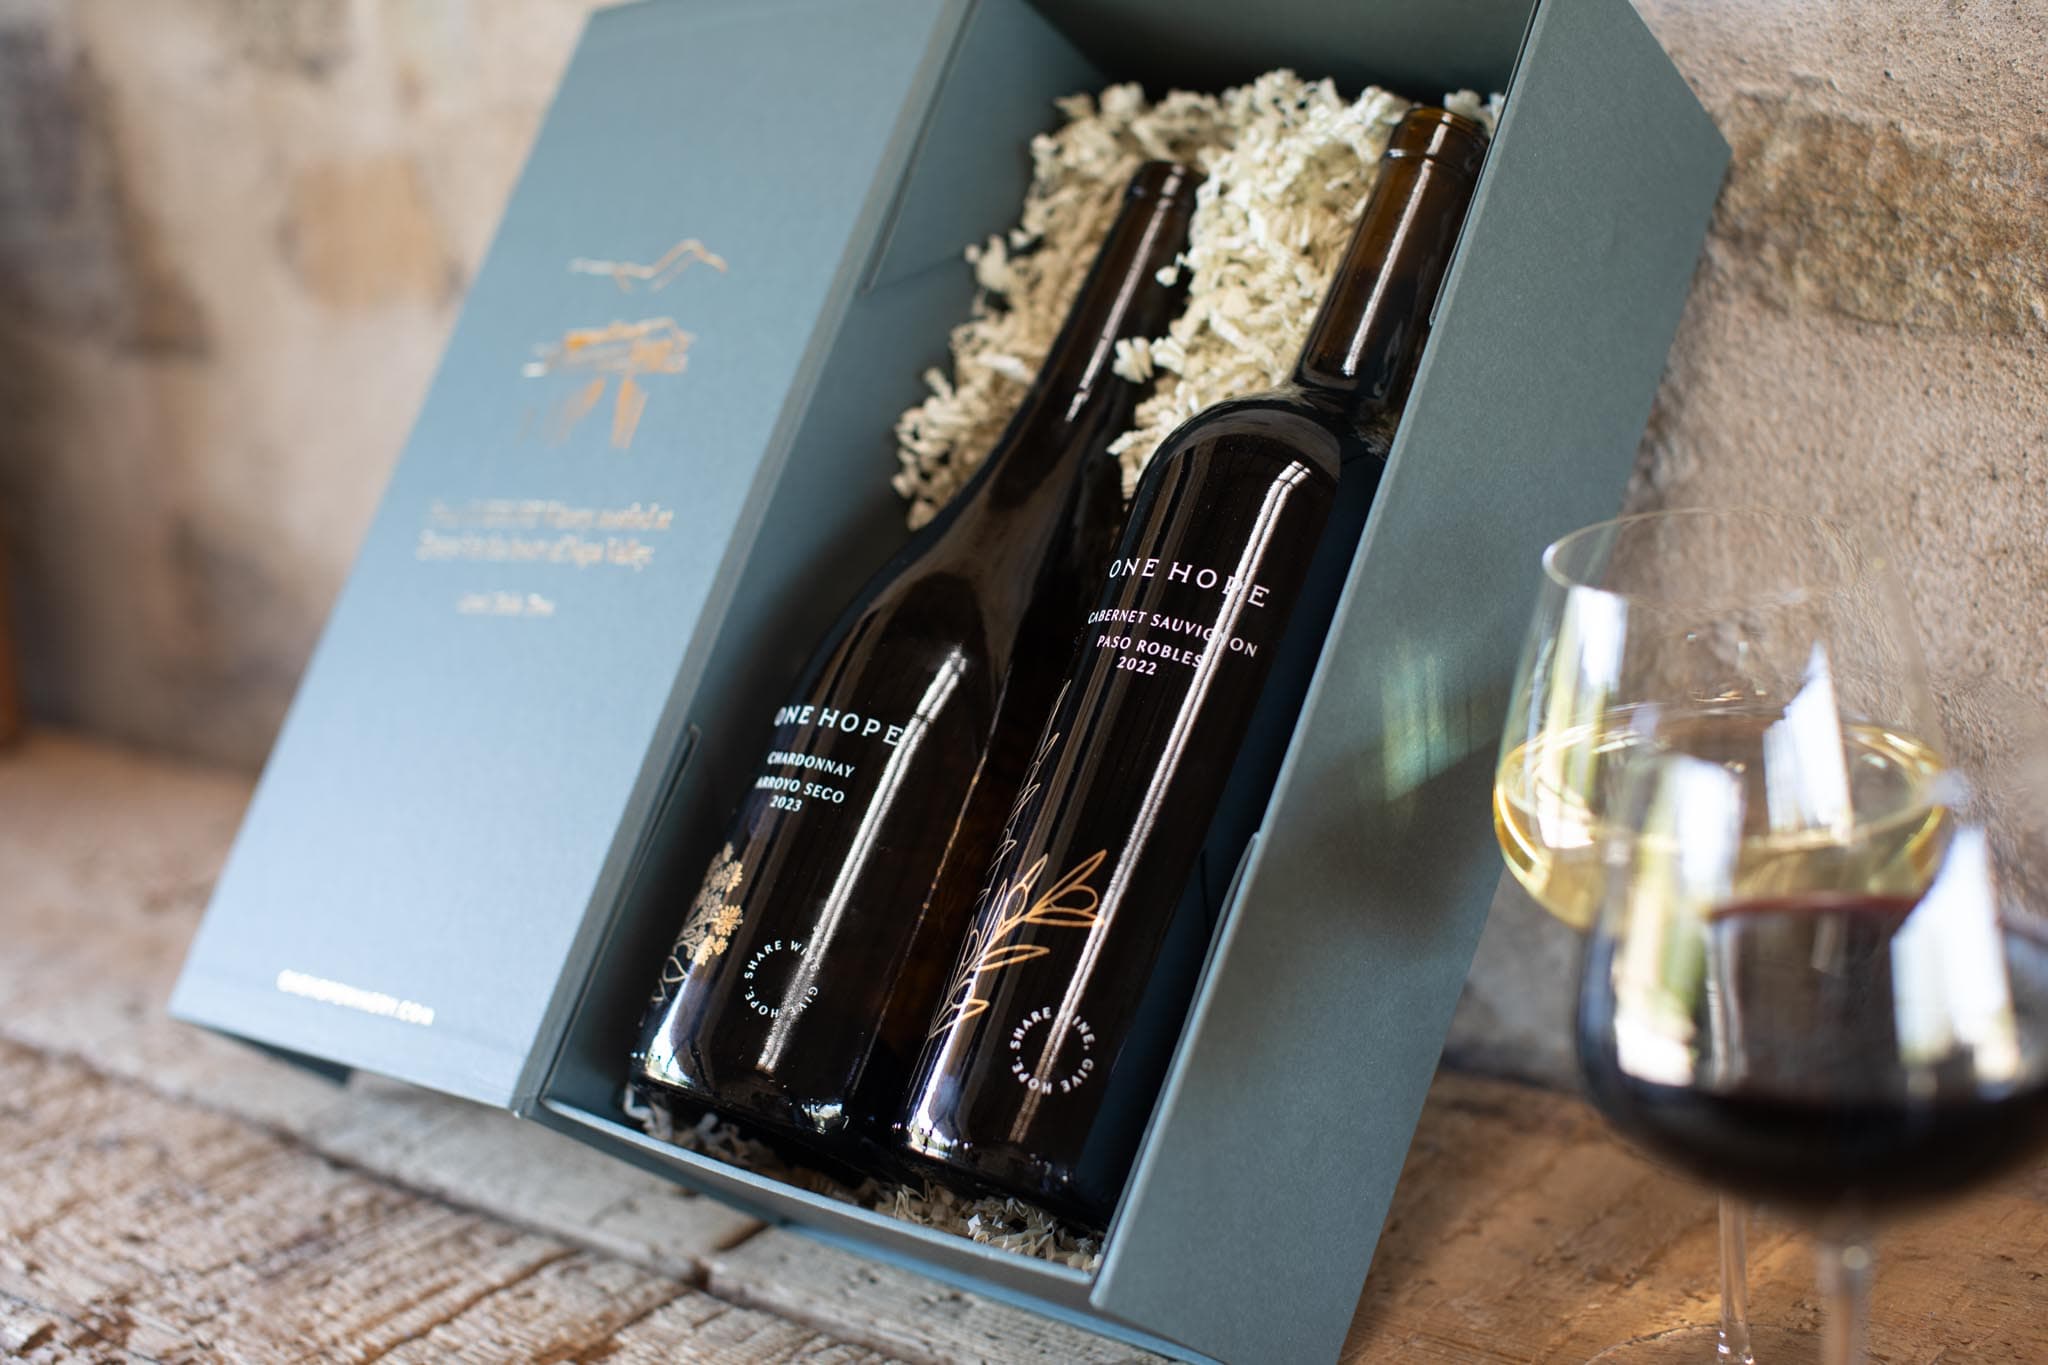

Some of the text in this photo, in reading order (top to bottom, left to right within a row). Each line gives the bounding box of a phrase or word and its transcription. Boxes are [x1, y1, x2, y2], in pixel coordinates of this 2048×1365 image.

[1109, 558, 1270, 608] ONE HOPE
[1088, 608, 1147, 624] CABERNET
[1096, 635, 1204, 668] PASO ROBLES
[1116, 656, 1157, 675] 2022
[774, 705, 904, 746] ONE HOPE
[767, 751, 855, 778] CHARDONNAY
[755, 776, 845, 803] ARROYO SECO
[769, 795, 802, 812] 2023
[744, 940, 782, 979] SHARE
[1009, 1006, 1052, 1050] SHARE
[1064, 1010, 1096, 1051] INE.
[1060, 1058, 1094, 1093] GIVE
